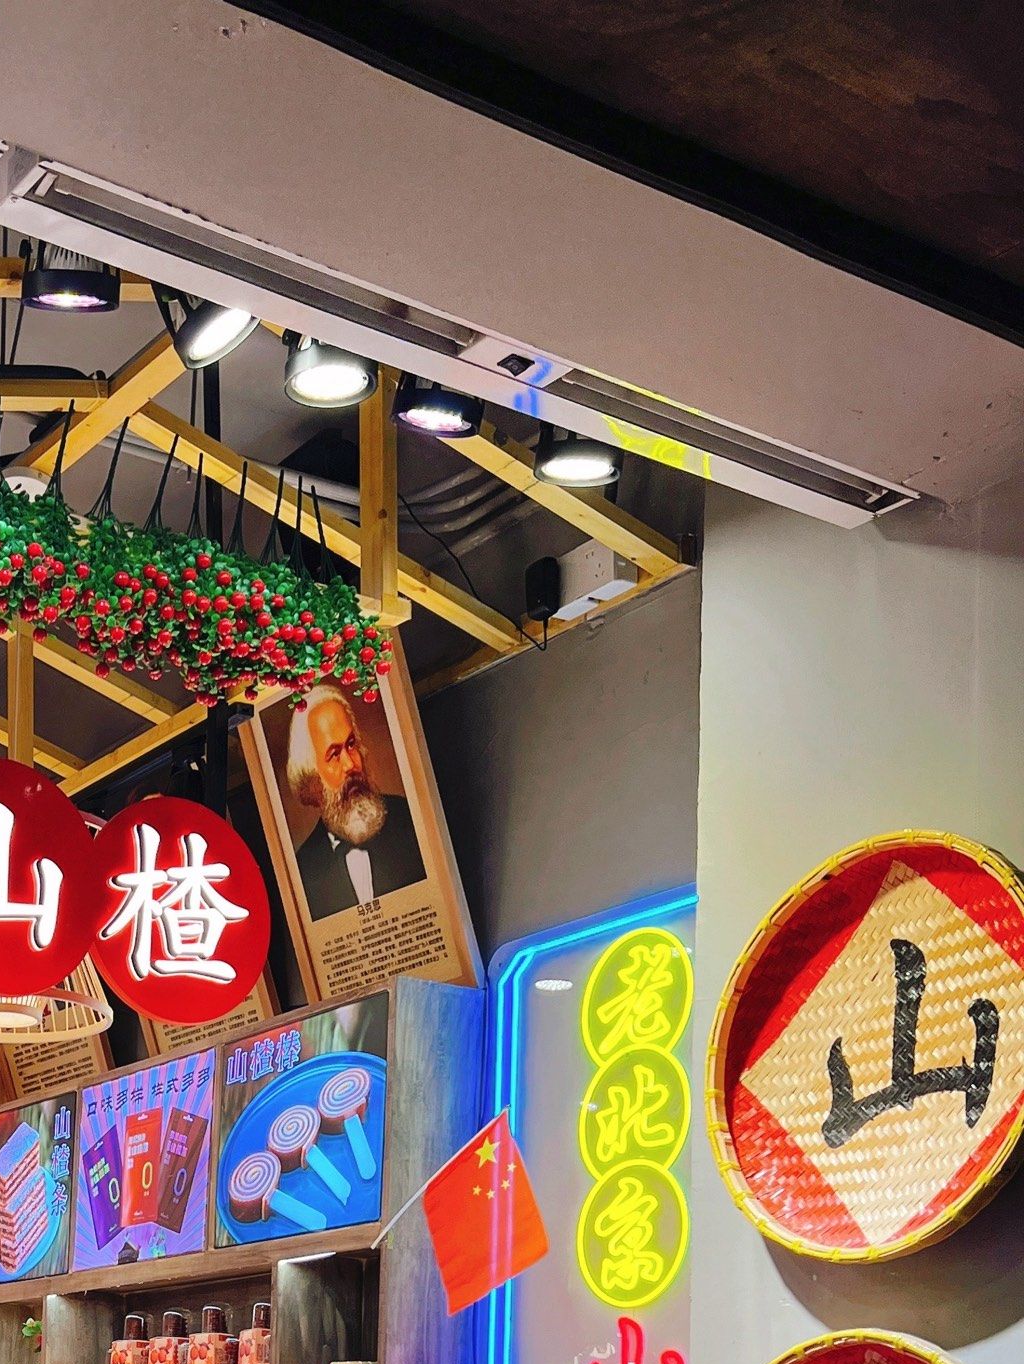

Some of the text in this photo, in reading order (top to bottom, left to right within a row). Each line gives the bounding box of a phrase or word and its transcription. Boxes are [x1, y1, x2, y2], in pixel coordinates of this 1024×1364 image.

[226, 1030, 302, 1086] 山楂棒
[821, 937, 1001, 1150] 山
[51, 1106, 71, 1216] 山楂条
